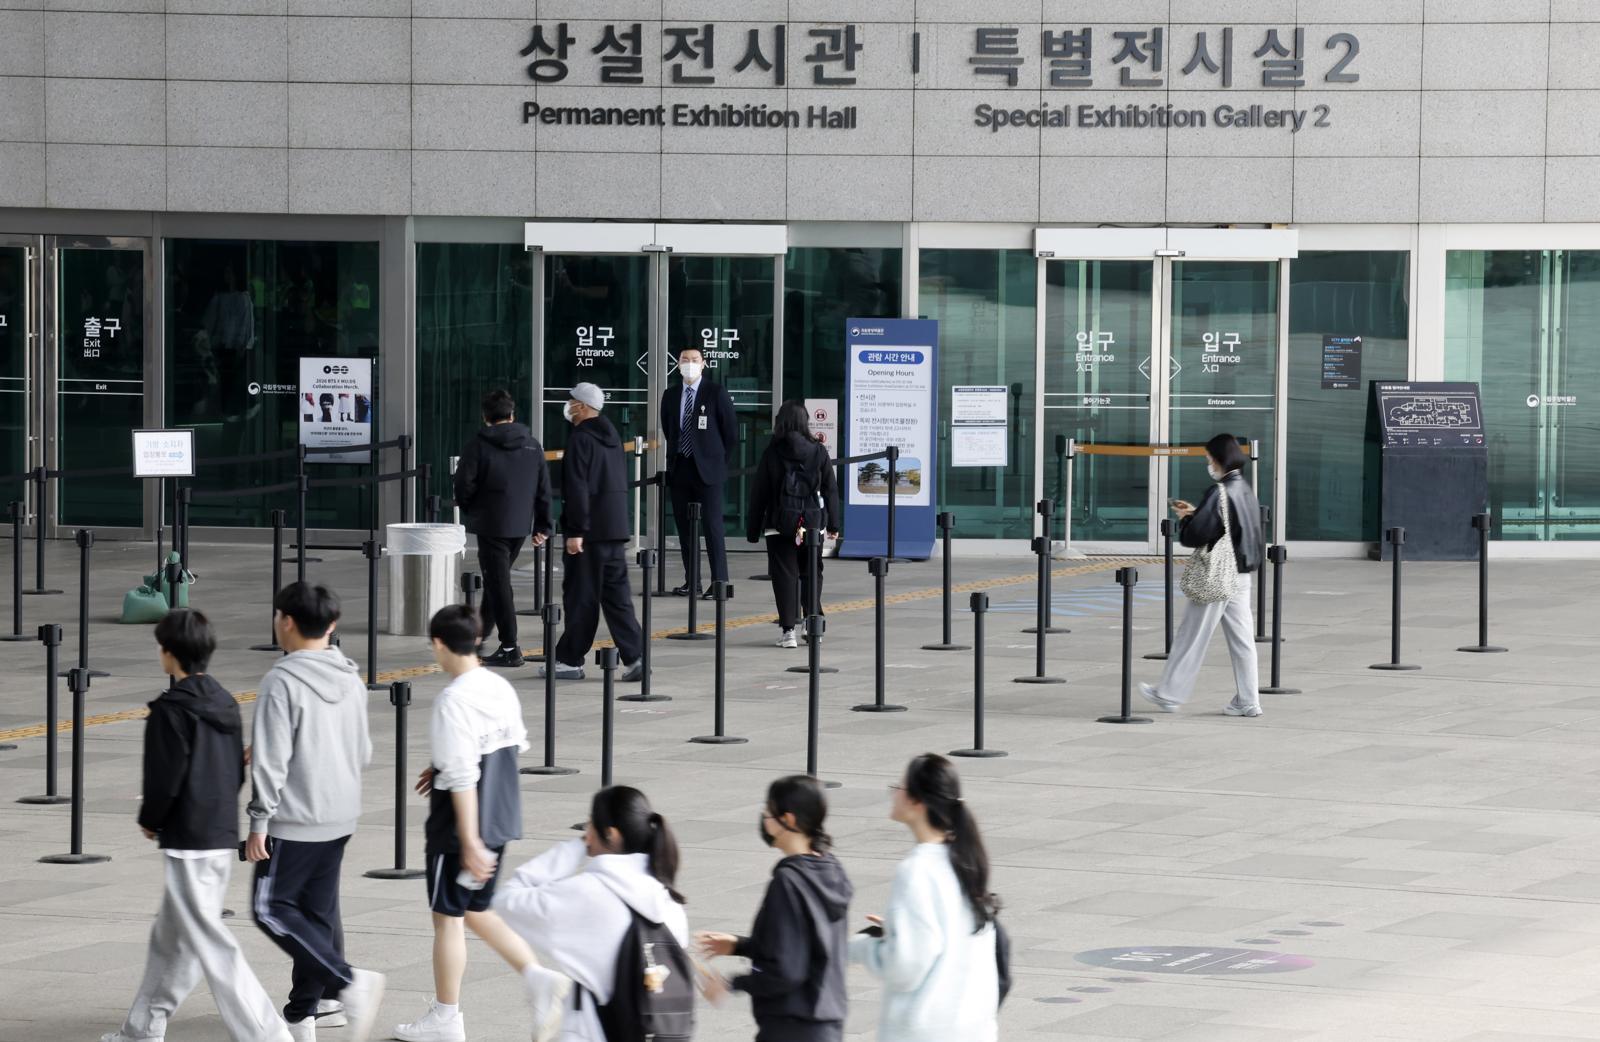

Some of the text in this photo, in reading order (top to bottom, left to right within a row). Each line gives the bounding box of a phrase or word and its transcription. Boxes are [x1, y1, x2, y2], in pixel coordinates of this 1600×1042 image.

[519, 23, 863, 86] 상설전시관
[522, 101, 857, 130] Permanent Exhibition Hall
[974, 102, 1331, 134] Special Exhibition Gallery 2
[84, 316, 122, 338] 출구
[576, 325, 615, 347] 입구
[701, 327, 740, 349] 입구
[1076, 330, 1116, 352] 입구
[83, 338, 101, 348] Exit
[1202, 331, 1242, 353] 입구
[83, 348, 101, 358] 出口
[576, 347, 615, 357] Entrance
[1075, 352, 1115, 362] Entrance
[576, 357, 594, 367] 入口
[867, 352, 915, 363] 관람 시간 안내
[1201, 353, 1241, 363] Entrance
[1076, 362, 1093, 372] 入口
[1202, 363, 1220, 373] 入口
[867, 368, 915, 377] Opening Hours
